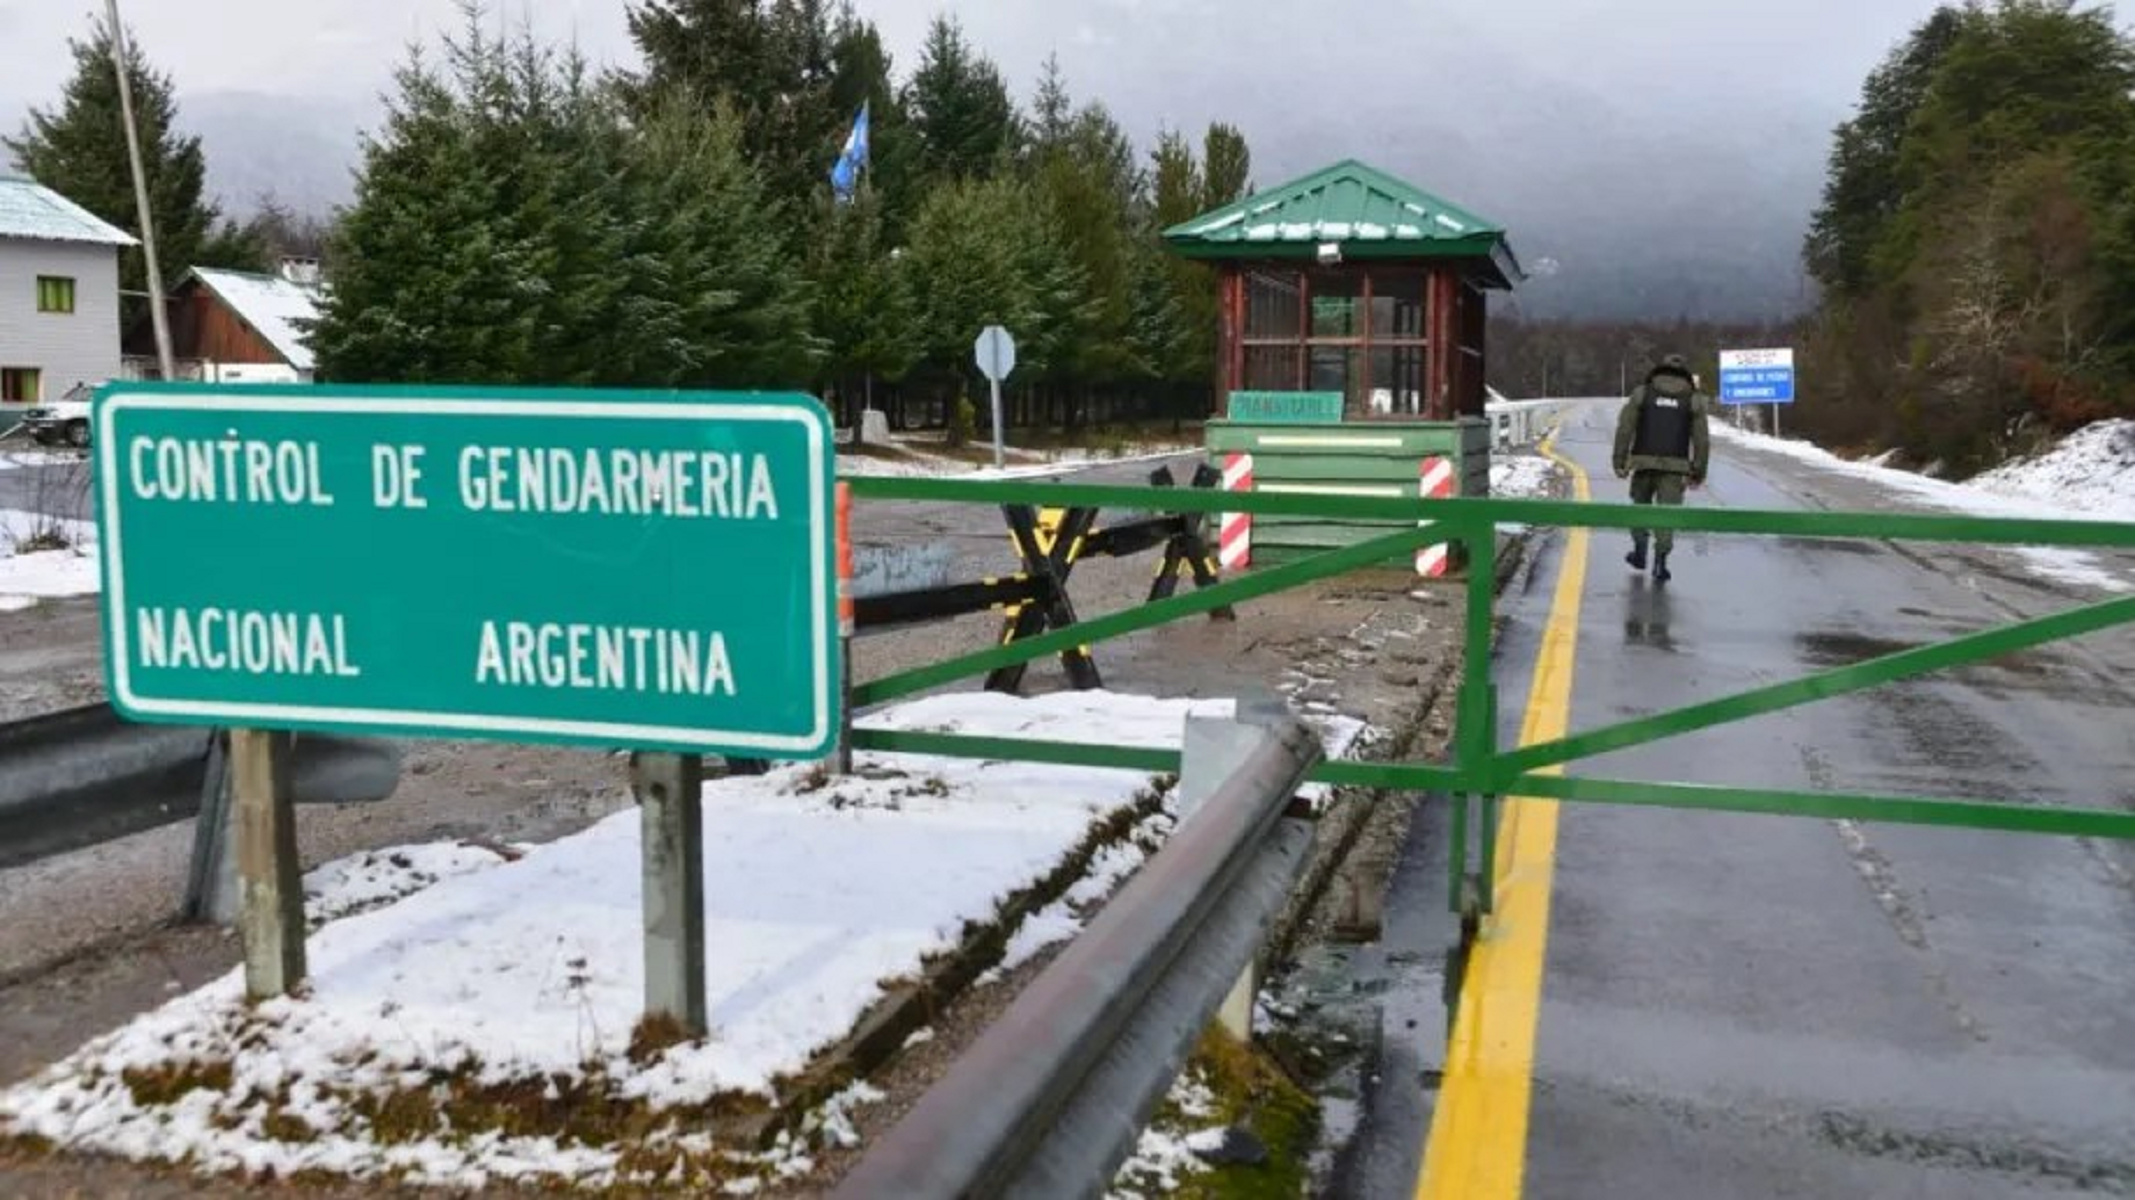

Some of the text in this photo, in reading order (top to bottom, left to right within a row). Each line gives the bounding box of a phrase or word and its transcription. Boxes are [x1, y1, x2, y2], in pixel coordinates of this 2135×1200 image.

[130, 435, 778, 519] CONTROL DE GENDARMERIA
[138, 607, 735, 695] NACIONAL ARGENTINA
